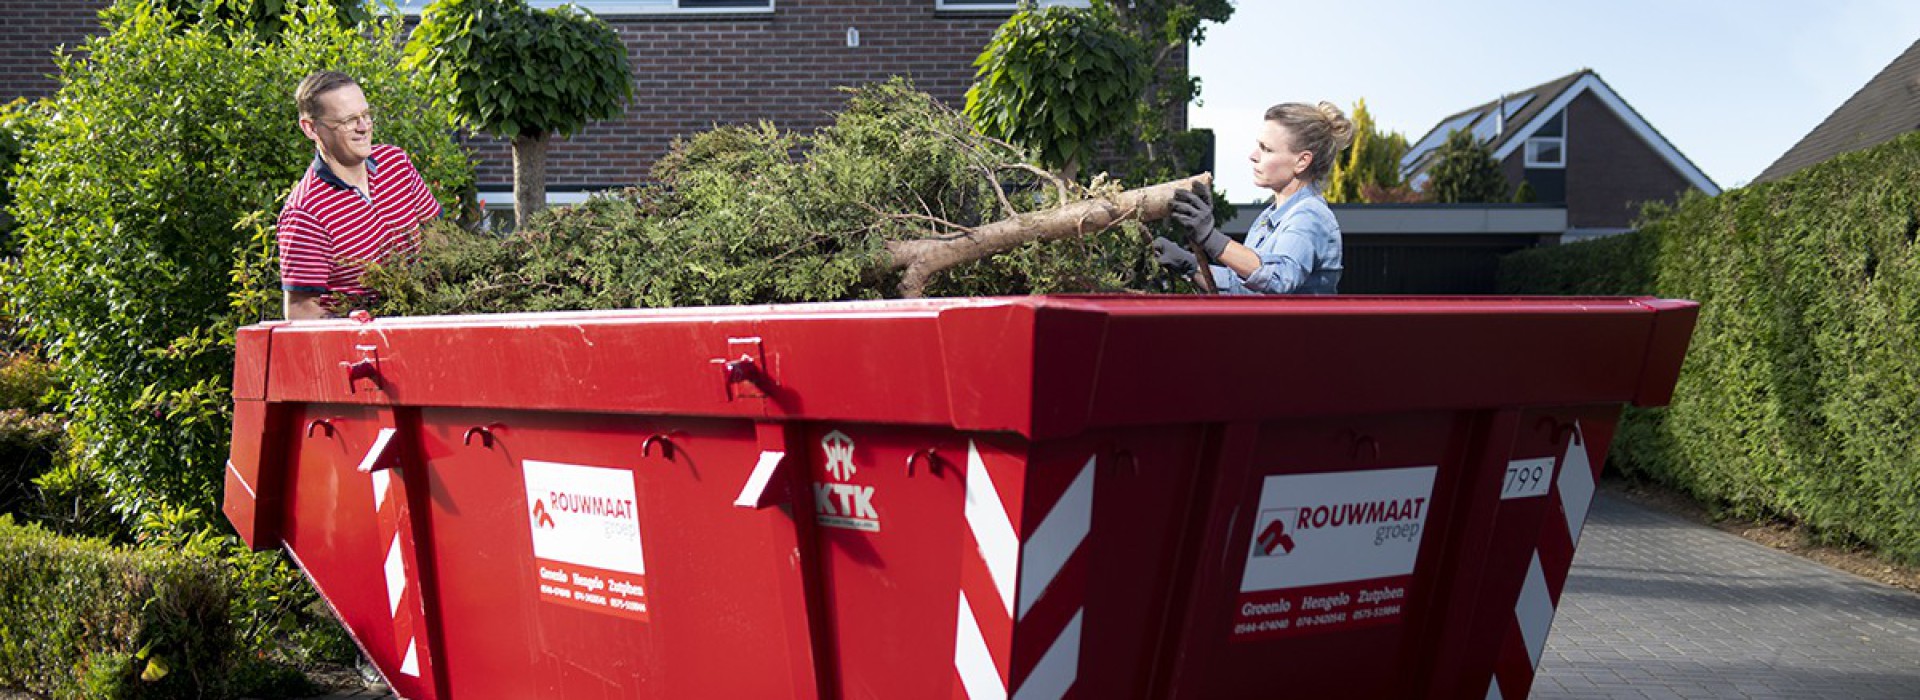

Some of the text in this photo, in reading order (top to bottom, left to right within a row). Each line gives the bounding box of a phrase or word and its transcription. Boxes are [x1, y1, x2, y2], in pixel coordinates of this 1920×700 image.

[1505, 466, 1543, 493] 799
[549, 491, 633, 519] ROUWMAAT
[813, 482, 879, 519] KTK
[1297, 497, 1425, 530] ROUWMAAT
[1374, 522, 1420, 546] groep
[1241, 586, 1405, 616] Groenlo Hengelo Zutphen
